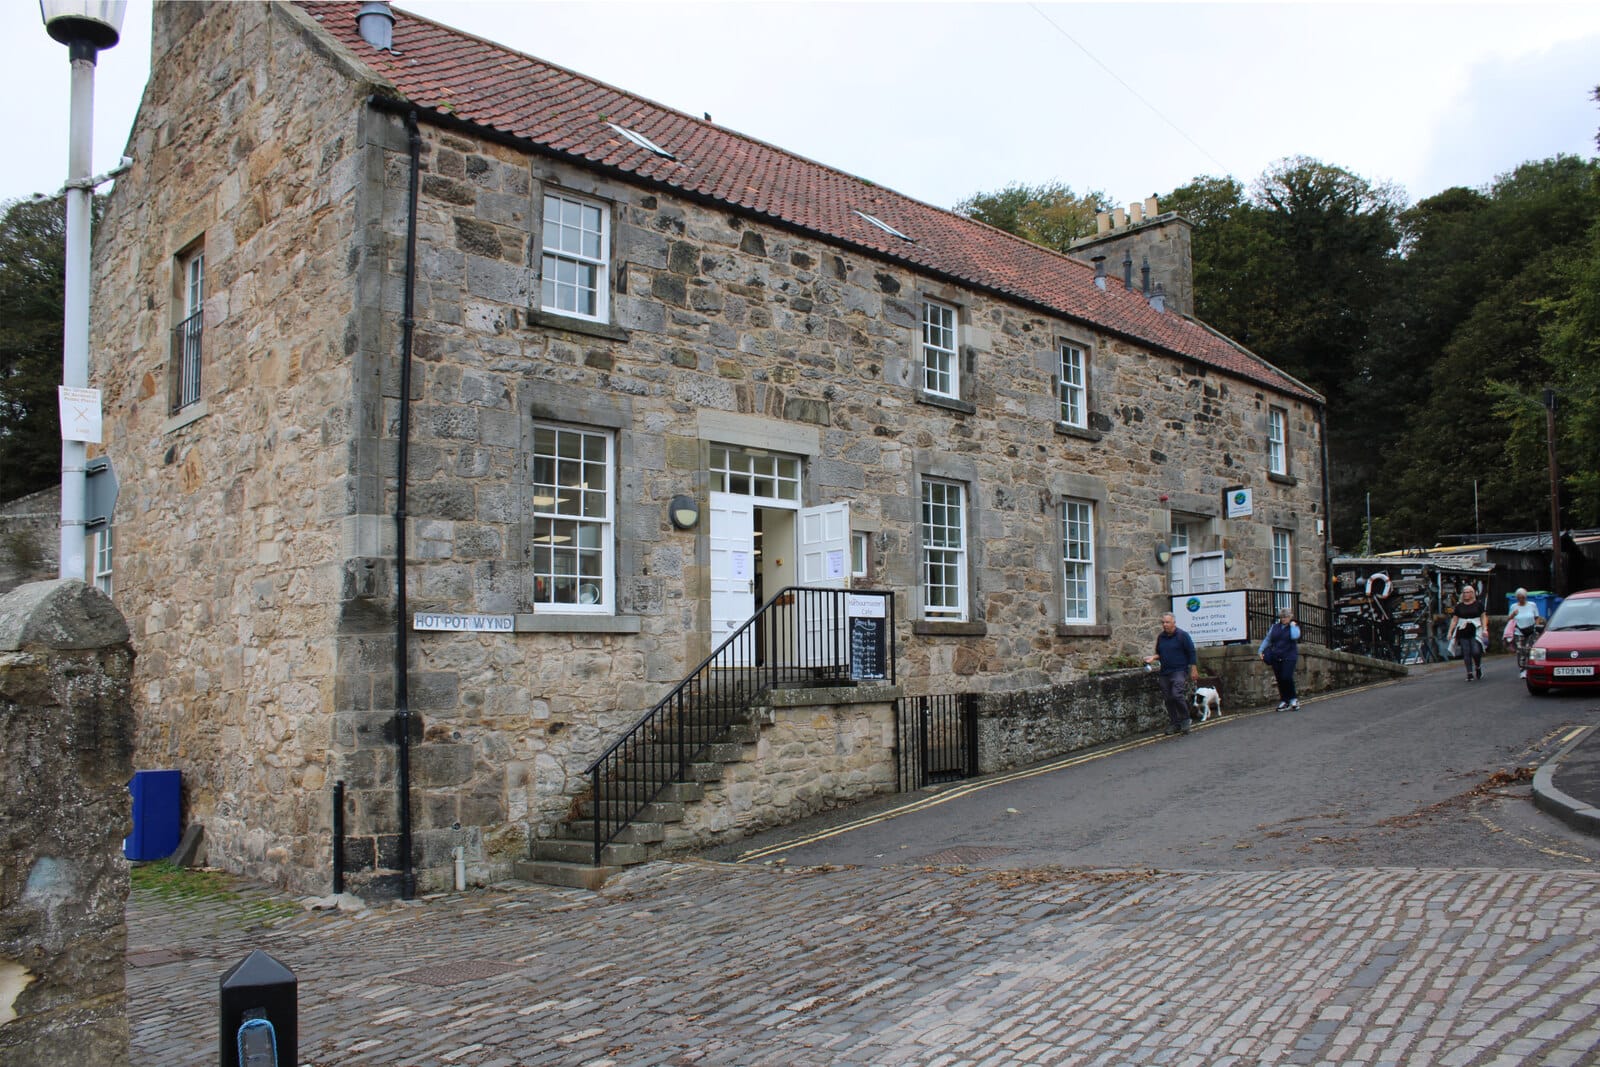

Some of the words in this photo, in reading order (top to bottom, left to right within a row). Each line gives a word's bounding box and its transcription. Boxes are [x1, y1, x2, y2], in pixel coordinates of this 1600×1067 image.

[416, 615, 441, 628] HOT
[444, 616, 468, 629] POT
[473, 617, 512, 630] WYND
